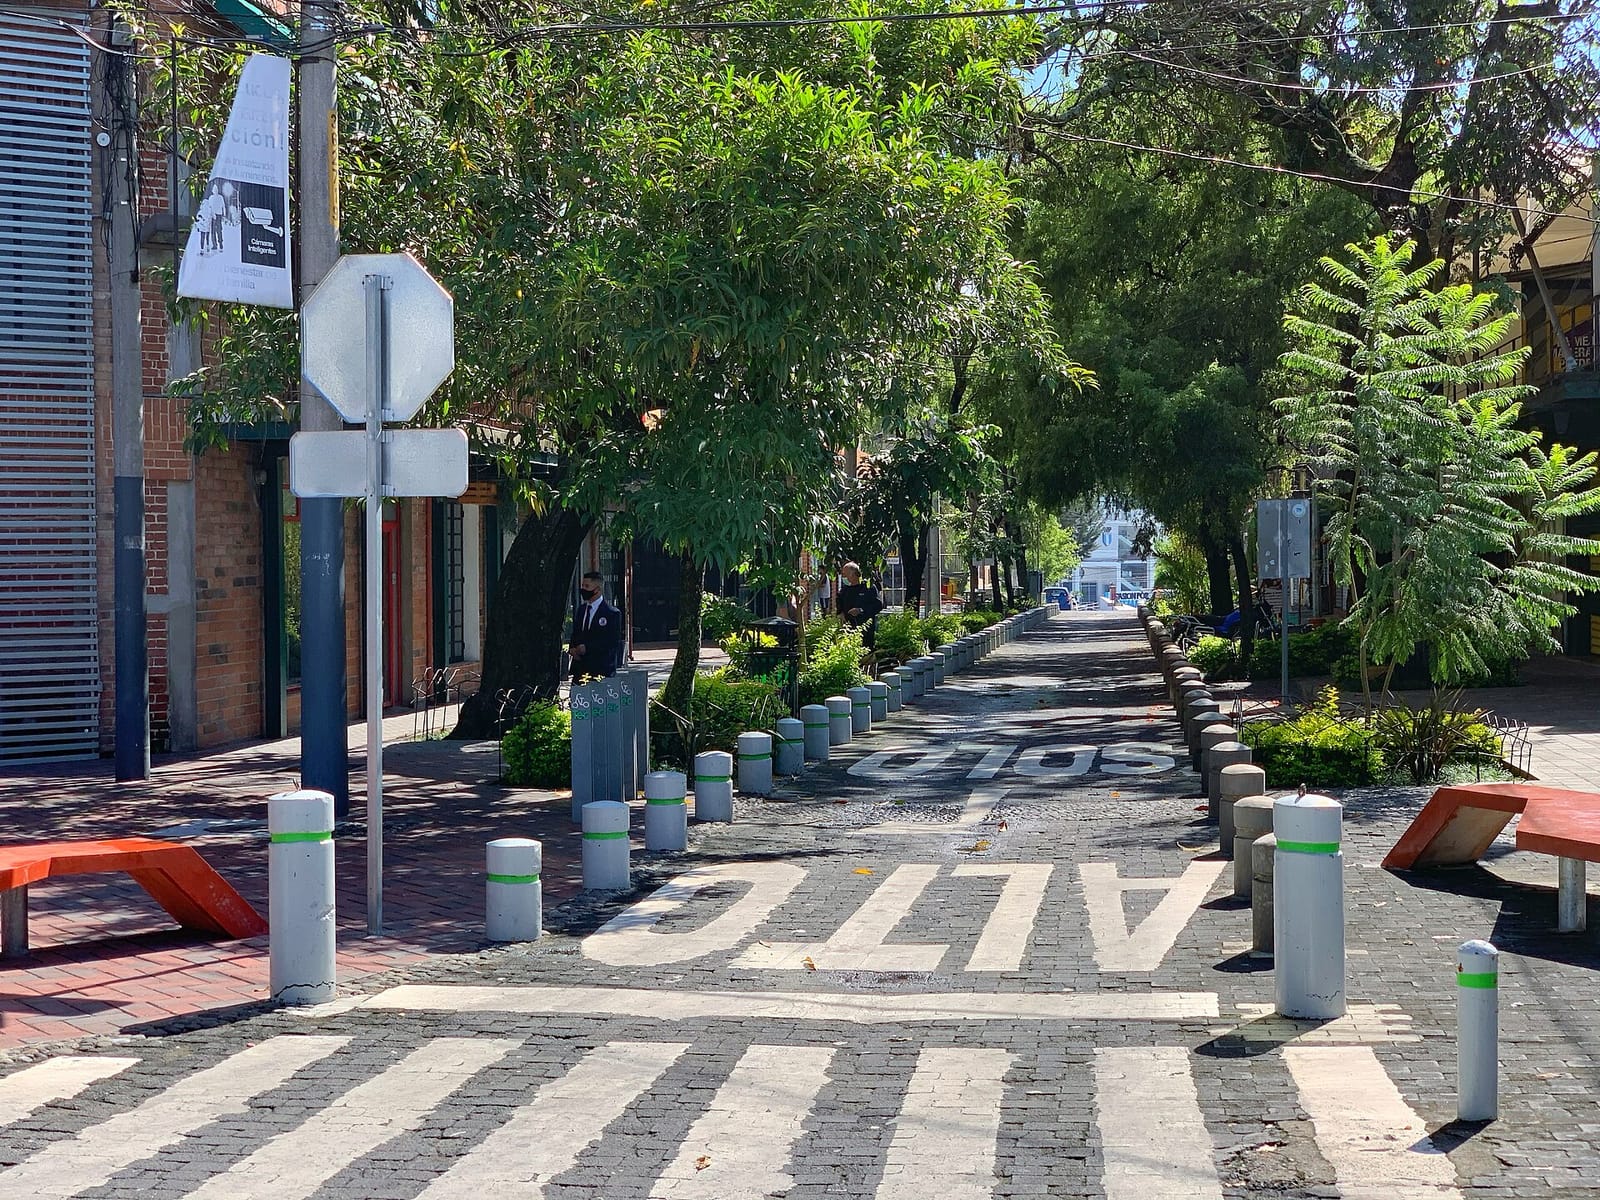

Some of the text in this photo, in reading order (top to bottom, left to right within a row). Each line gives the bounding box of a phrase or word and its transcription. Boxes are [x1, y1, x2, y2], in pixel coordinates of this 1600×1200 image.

[247, 244, 277, 254] Inteligentes
[251, 238, 274, 247] Cámaras
[846, 741, 1176, 779] SOLO
[580, 860, 1230, 973] ALTO
